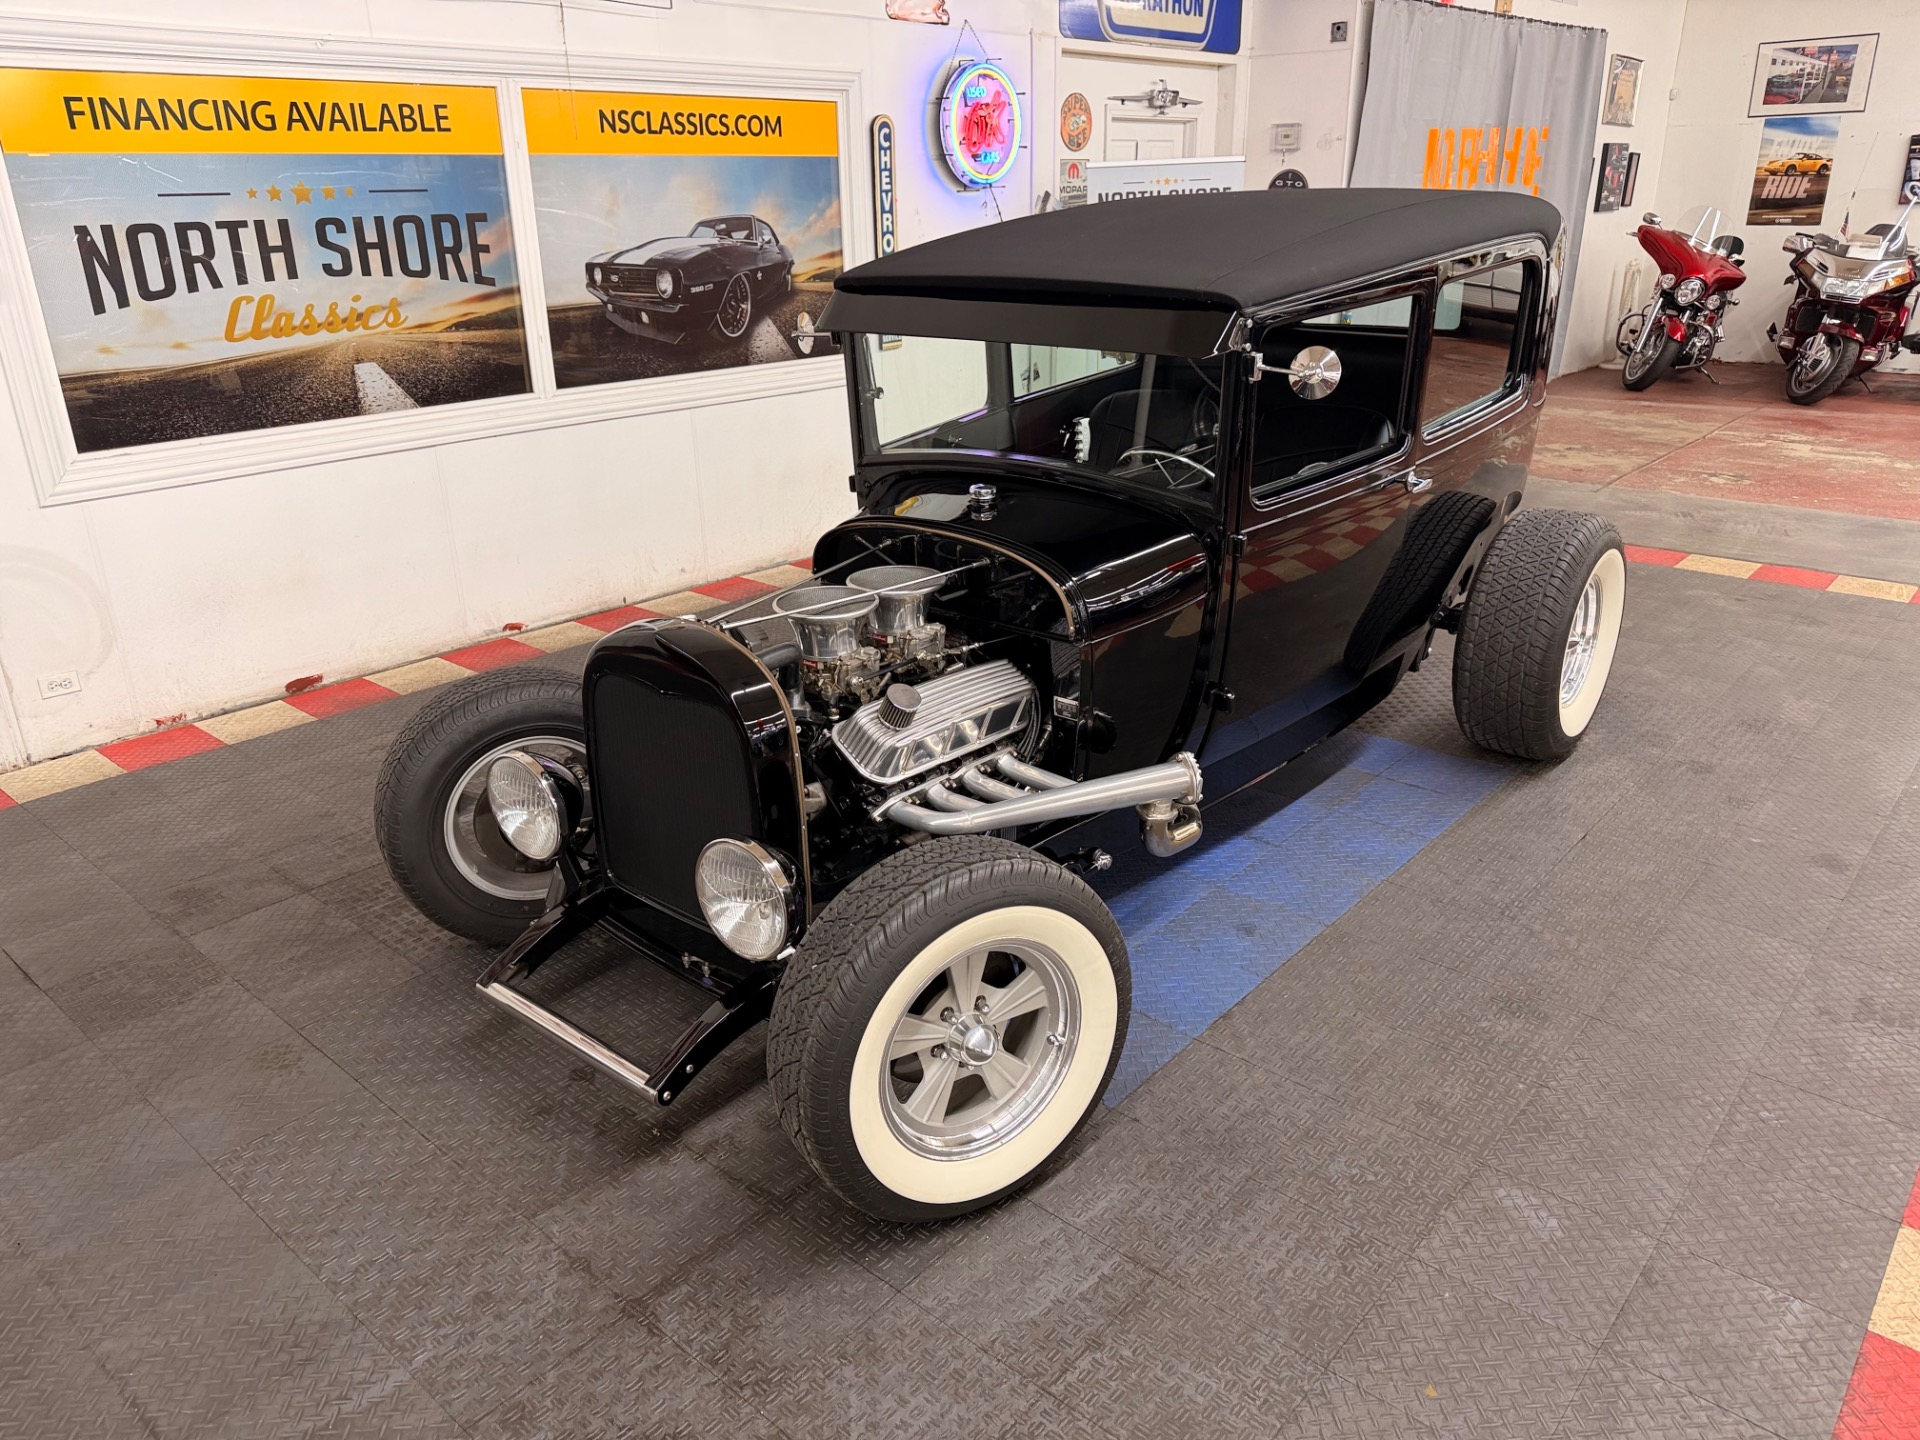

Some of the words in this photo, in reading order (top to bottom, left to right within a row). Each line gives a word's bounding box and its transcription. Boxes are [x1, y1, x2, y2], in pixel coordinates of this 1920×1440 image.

[966, 86, 987, 98] USED
[1063, 95, 1090, 116] SUPER
[63, 96, 277, 132] FINANCING
[286, 101, 452, 133] AVAILABLE
[599, 108, 782, 138] NSCLASSICS.COM
[1068, 128, 1087, 148] BEE
[879, 127, 895, 254] CHEVRO
[1275, 179, 1303, 188] GTO
[1761, 175, 1814, 199] RIDE
[73, 218, 300, 316] NORTH
[314, 212, 497, 288] SHORE
[223, 293, 409, 343] Classics
